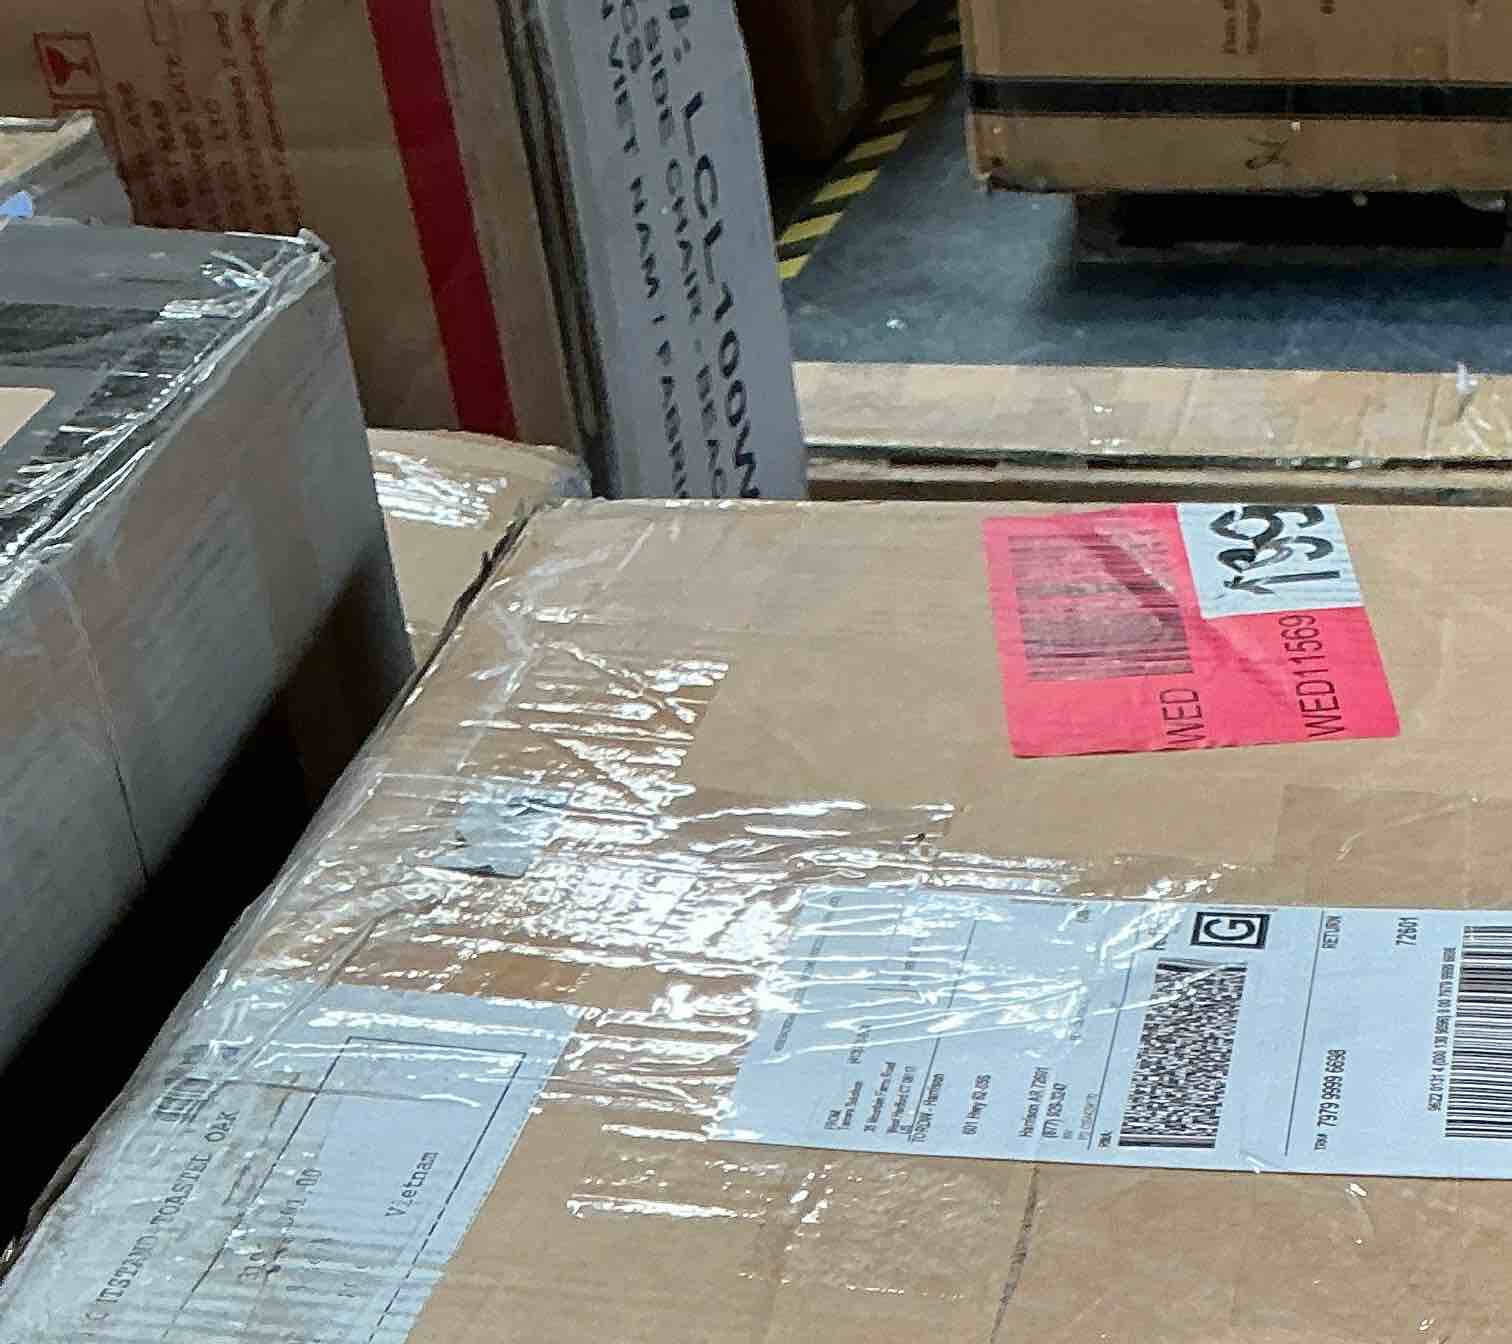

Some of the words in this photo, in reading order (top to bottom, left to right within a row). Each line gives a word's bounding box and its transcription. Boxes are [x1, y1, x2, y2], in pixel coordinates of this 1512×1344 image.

[1278, 614, 1345, 738] WED11569
[1160, 688, 1205, 745] WED
[1203, 918, 1256, 941] G
[1321, 915, 1342, 949] RETURN
[1395, 917, 1417, 946] 72601
[1321, 1076, 1342, 1100] 9999
[1317, 1103, 1340, 1127] 7979
